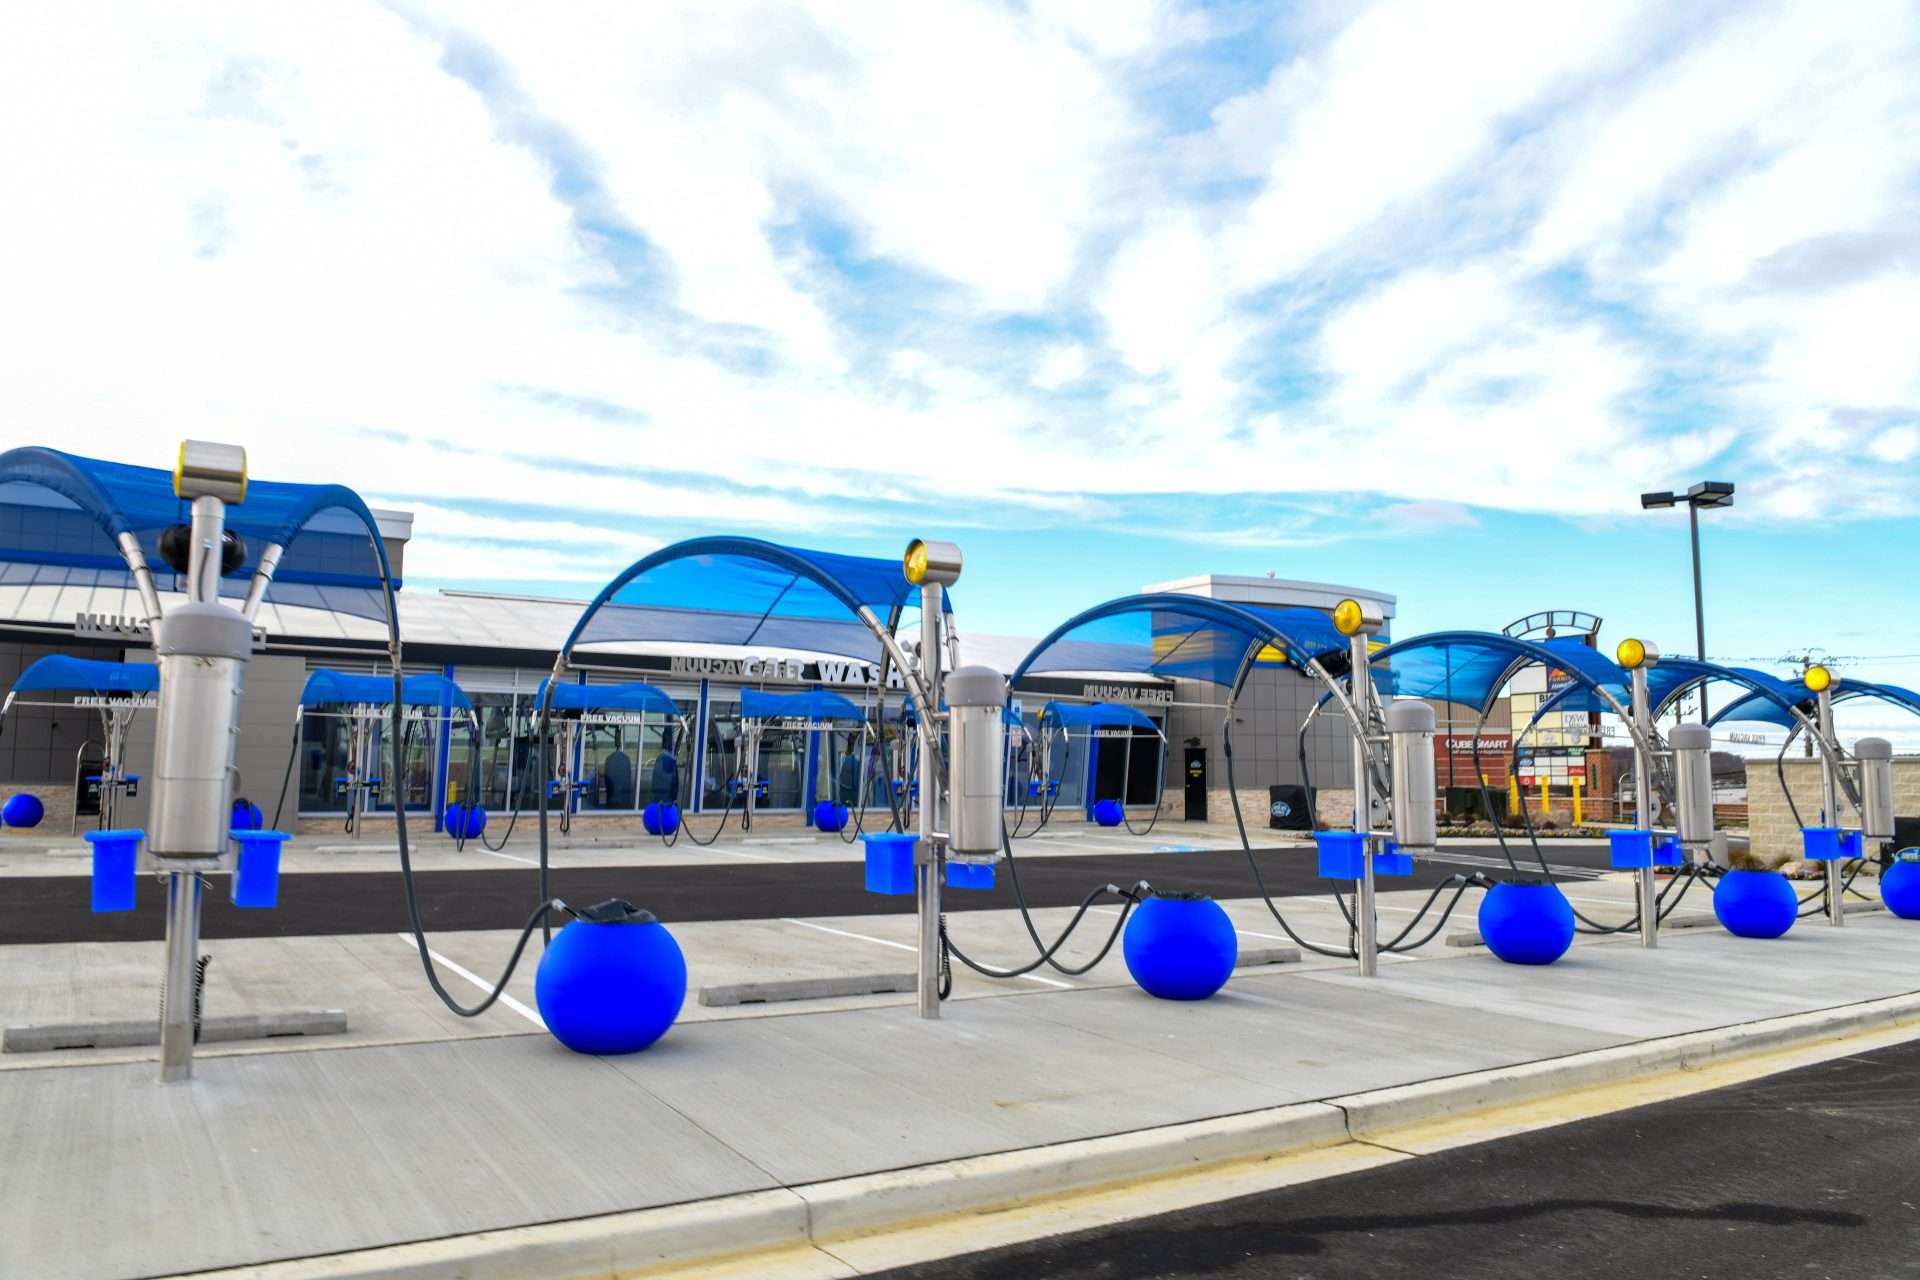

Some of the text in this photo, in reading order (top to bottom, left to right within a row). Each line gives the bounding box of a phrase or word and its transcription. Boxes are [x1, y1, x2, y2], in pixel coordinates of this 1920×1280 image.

[816, 660, 906, 688] WASH
[74, 696, 157, 708] FREE VACUUM
[382, 709, 423, 719] VAUUM
[580, 714, 640, 724] FREE VACUUM
[803, 721, 833, 731] VACUUM
